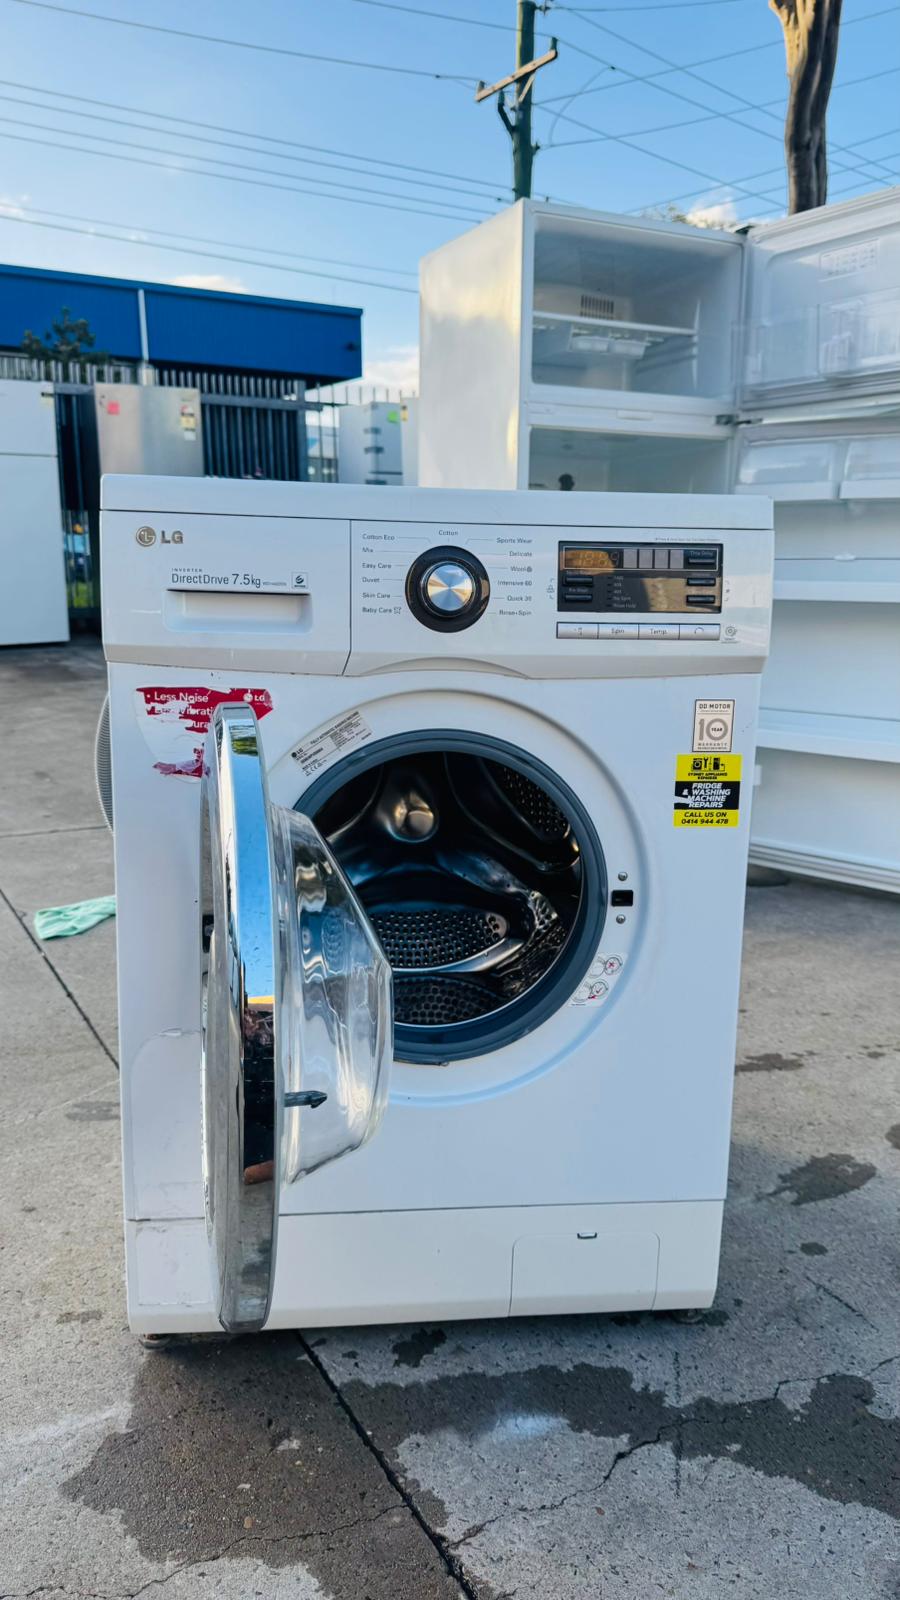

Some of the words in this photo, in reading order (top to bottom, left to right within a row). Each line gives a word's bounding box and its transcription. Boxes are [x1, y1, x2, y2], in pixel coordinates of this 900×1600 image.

[161, 530, 184, 544] LG
[362, 562, 376, 570] Easy
[232, 574, 261, 588] 7.5kg
[611, 627, 625, 635] Spin
[154, 691, 176, 702] Less
[179, 692, 209, 703] Noise
[698, 718, 729, 741] 10
